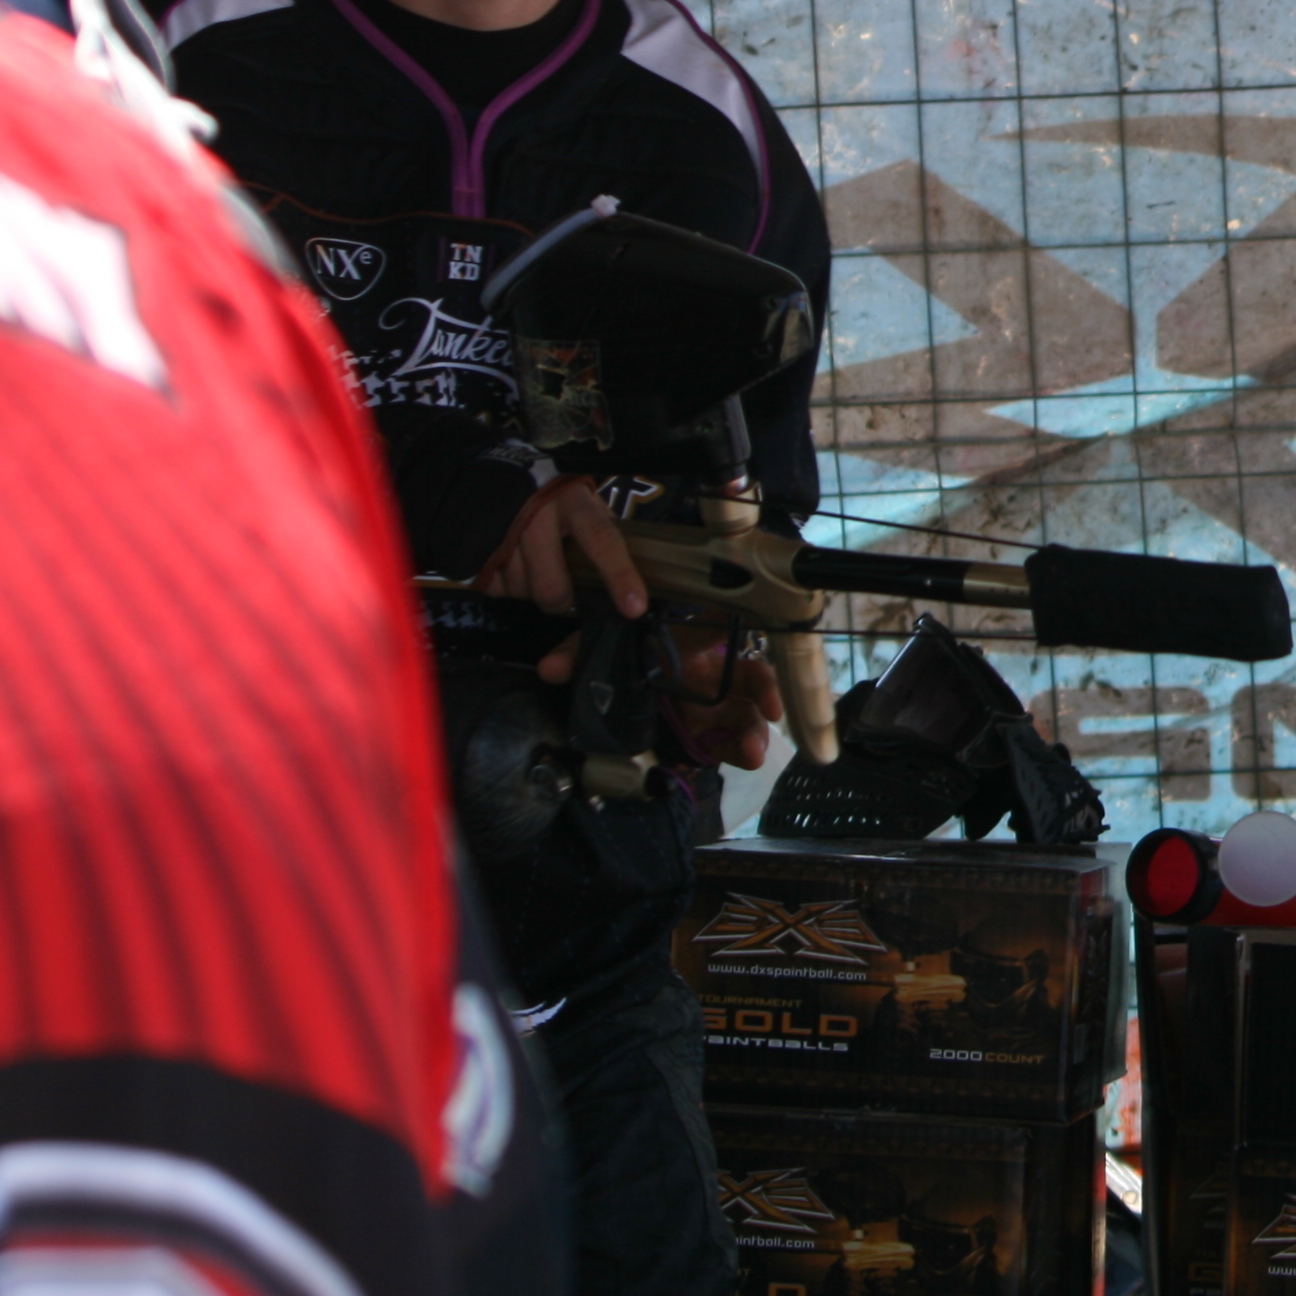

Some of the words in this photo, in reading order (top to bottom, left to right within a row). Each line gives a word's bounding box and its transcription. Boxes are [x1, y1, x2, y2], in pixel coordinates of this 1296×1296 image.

[707, 963, 867, 982] www.dxspaintball.com
[702, 1035, 849, 1052] AINTBALLS
[929, 1048, 983, 1062] 2000
[984, 1052, 1046, 1065] COUNT
